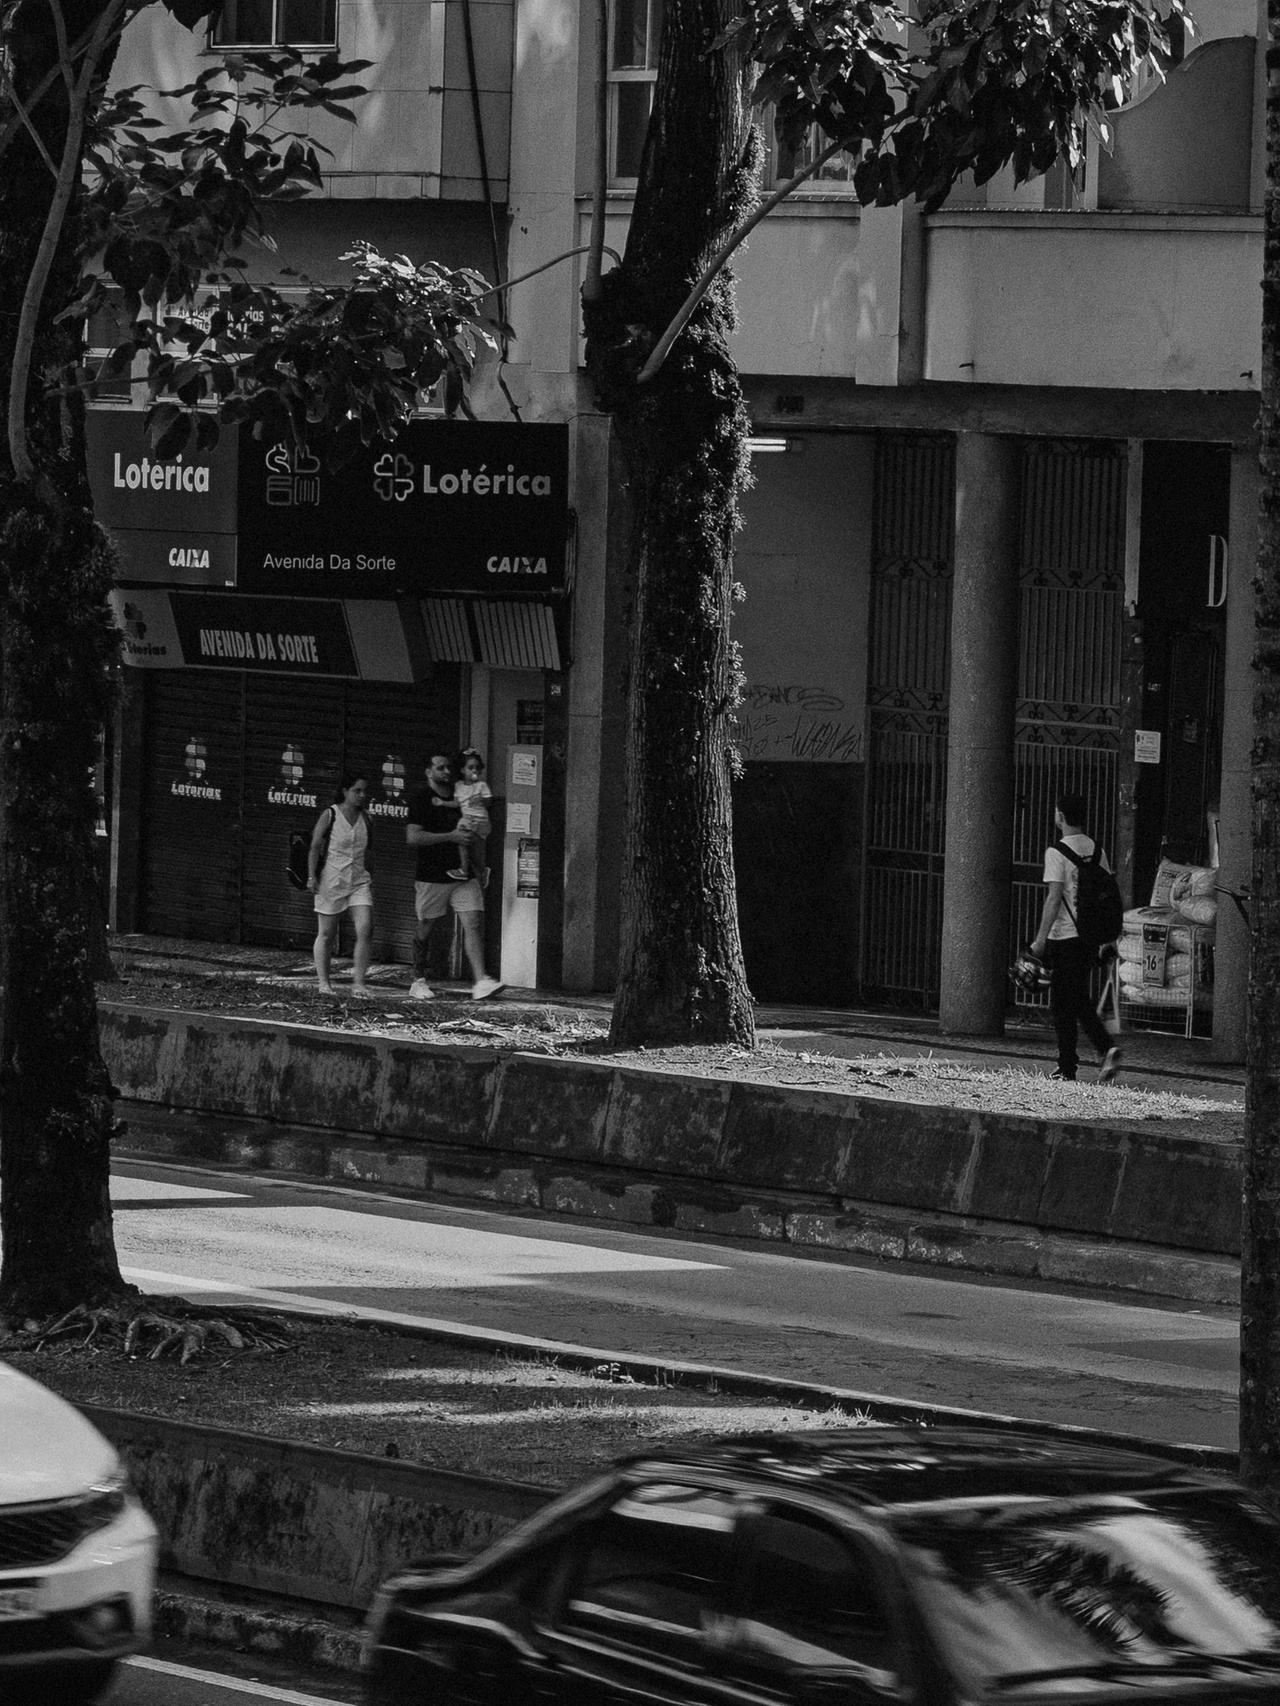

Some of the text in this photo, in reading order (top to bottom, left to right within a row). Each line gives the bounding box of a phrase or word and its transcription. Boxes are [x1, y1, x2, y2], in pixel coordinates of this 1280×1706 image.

[423, 463, 551, 496] Lotérica
[168, 547, 210, 569] CAIXA
[263, 553, 396, 570] Avenida Da Sorte
[486, 555, 548, 575] CAIXA
[200, 628, 320, 663] AVENIDA DA SORTE
[369, 798, 409, 818] Loteri
[1147, 954, 1157, 971] 16
